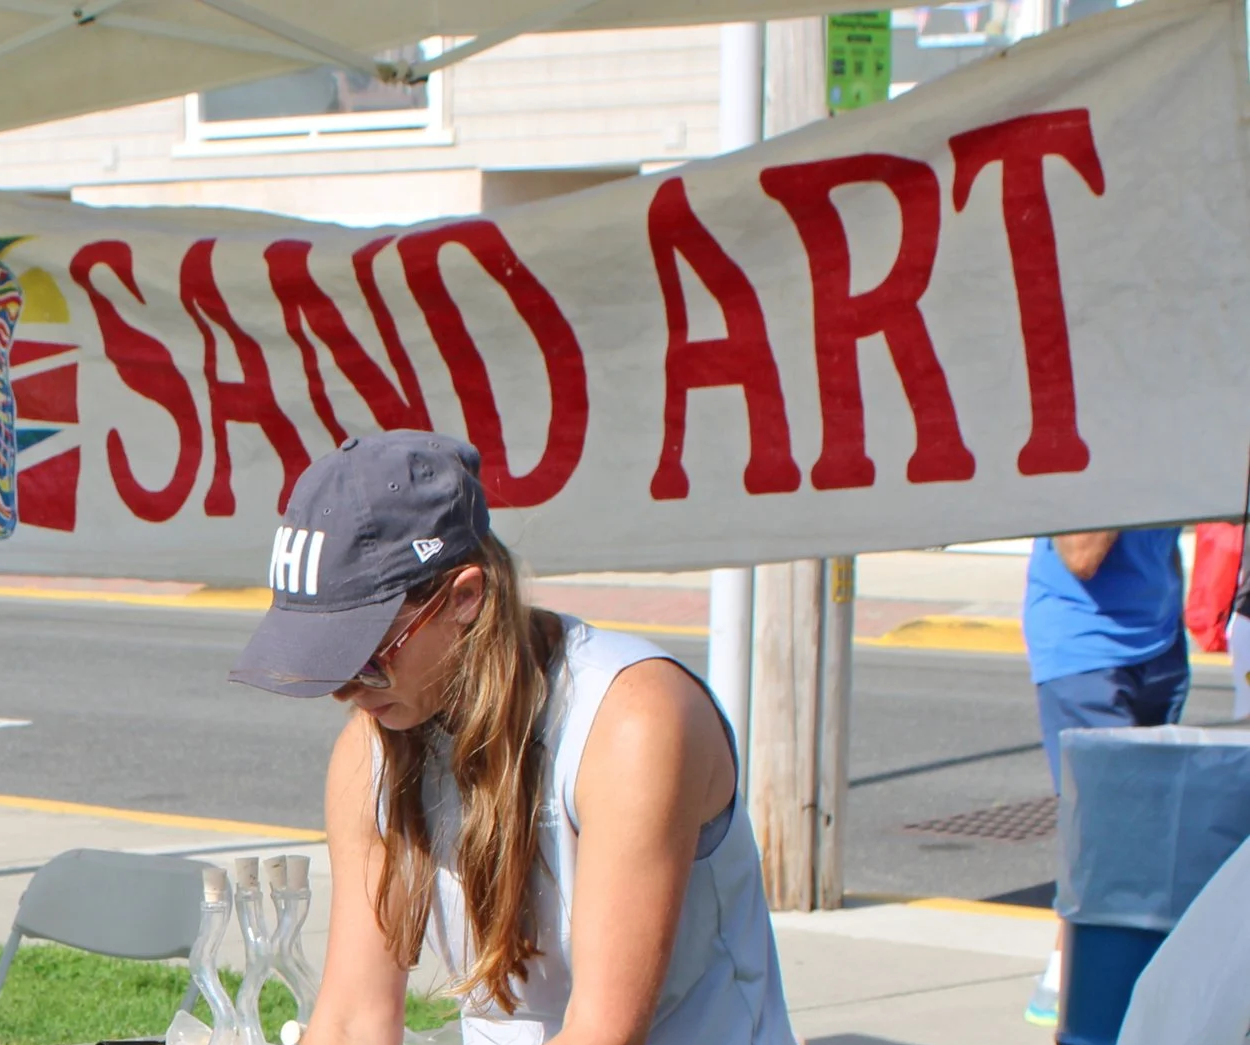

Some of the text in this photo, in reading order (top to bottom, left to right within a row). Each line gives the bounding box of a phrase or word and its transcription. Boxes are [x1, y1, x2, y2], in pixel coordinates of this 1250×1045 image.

[69, 108, 1105, 523] SAND ART
[269, 526, 325, 596] HI
